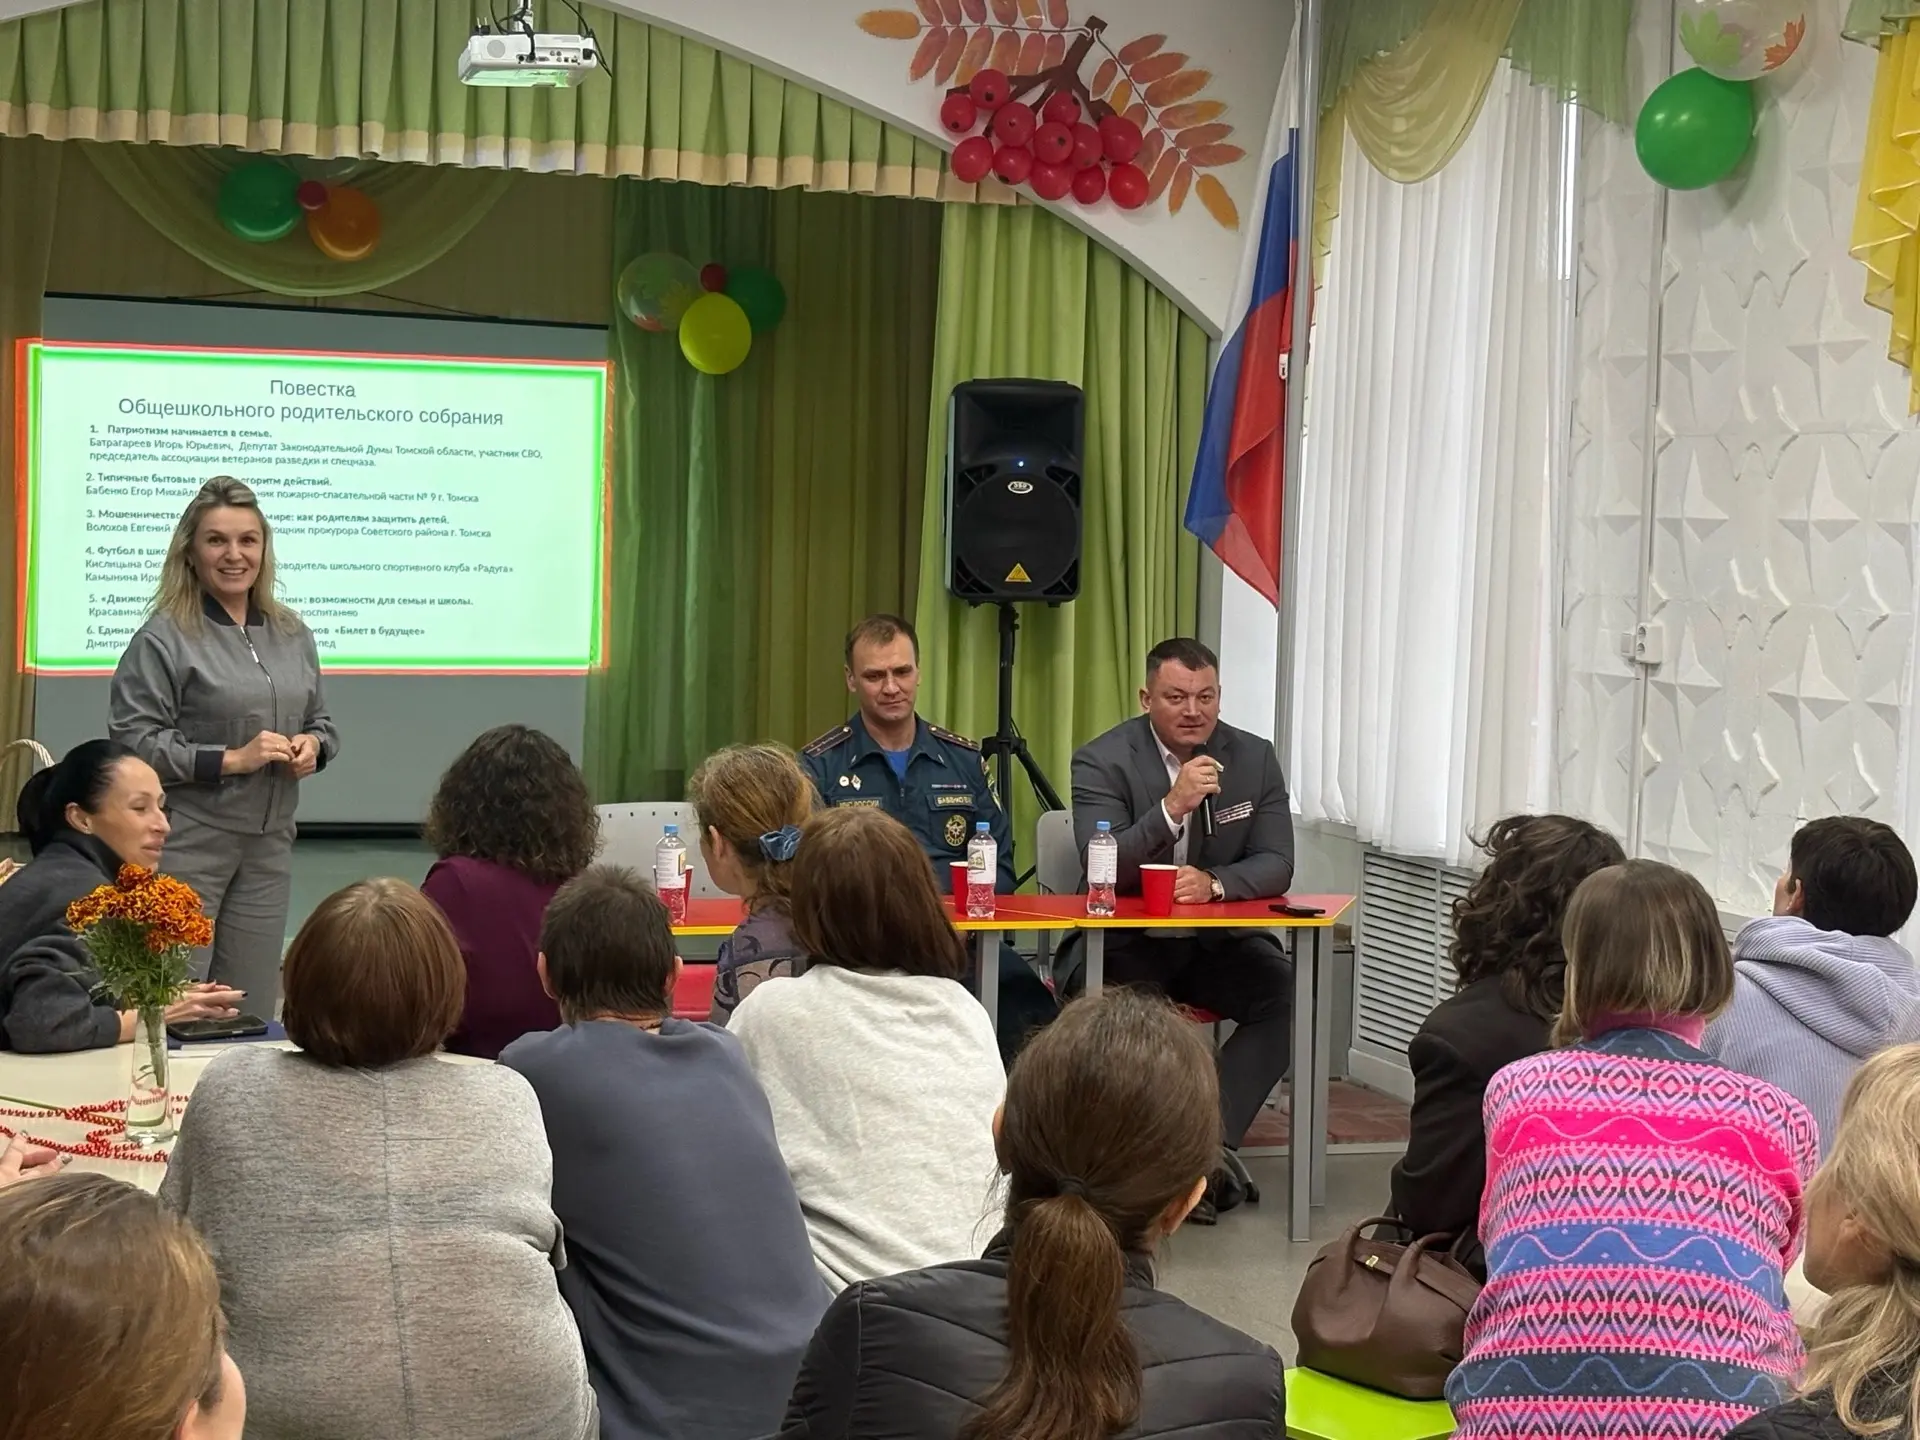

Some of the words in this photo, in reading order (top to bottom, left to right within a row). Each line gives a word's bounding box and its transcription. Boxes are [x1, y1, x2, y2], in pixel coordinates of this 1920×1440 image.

[270, 380, 356, 397] Повестка
[118, 398, 275, 419] Общешкольного
[281, 405, 413, 423] родительского
[419, 408, 503, 427] собрания
[90, 425, 99, 434] 1.
[108, 425, 168, 436] Патриотизм
[171, 428, 228, 437] начинается
[239, 430, 272, 438] семье.
[90, 438, 152, 448] Батрагареев
[154, 440, 183, 450] Игорь
[186, 440, 233, 452] Юрьевич,
[239, 442, 278, 452] Депутат
[280, 442, 364, 453] Законодательной
[366, 445, 392, 456] Думы
[396, 446, 434, 455] Томской
[436, 446, 476, 458] области,
[479, 449, 520, 459] участник
[521, 448, 543, 459] СВО,
[90, 452, 158, 462] председатель
[162, 454, 219, 464] ассоциации
[222, 456, 272, 464] ветеранов
[276, 457, 320, 466] разведки
[330, 458, 376, 467] спецназа.
[86, 472, 95, 482] 2.
[98, 472, 148, 482] Типичные
[152, 474, 196, 483] бытовые
[242, 478, 280, 487] горитм
[284, 477, 332, 487] действий.
[86, 485, 128, 496] Бабенко
[130, 486, 152, 498] Егор
[277, 490, 386, 500] пожарно-спасательной
[389, 492, 414, 501] части
[416, 492, 428, 501] №
[430, 492, 436, 502] 9
[446, 493, 480, 502] Томска
[86, 509, 95, 518] 3.
[316, 514, 370, 523] родителям
[372, 515, 416, 524] защитить
[418, 516, 450, 525] детей.
[86, 522, 128, 532] Волохов
[130, 523, 170, 532] Евгений
[272, 527, 306, 536] ощник
[308, 526, 359, 536] прокурора
[361, 526, 412, 536] Советского
[415, 528, 448, 538] района
[459, 528, 492, 538] Томска
[85, 546, 94, 555] 4.
[98, 546, 136, 556] Футбол
[86, 560, 142, 570] Кислицына
[276, 562, 328, 572] оводитель
[330, 563, 380, 571] школьного
[382, 564, 442, 572] спортивного
[444, 563, 470, 573] клуба
[473, 564, 514, 574] «Радуга»
[86, 573, 138, 582] Камынина
[88, 594, 98, 603] 5.
[377, 597, 396, 606] для
[88, 608, 142, 617] Красавина
[86, 626, 96, 635] 6.
[98, 626, 135, 636] Единая
[335, 626, 368, 635] «Билет
[378, 626, 426, 636] будущее»
